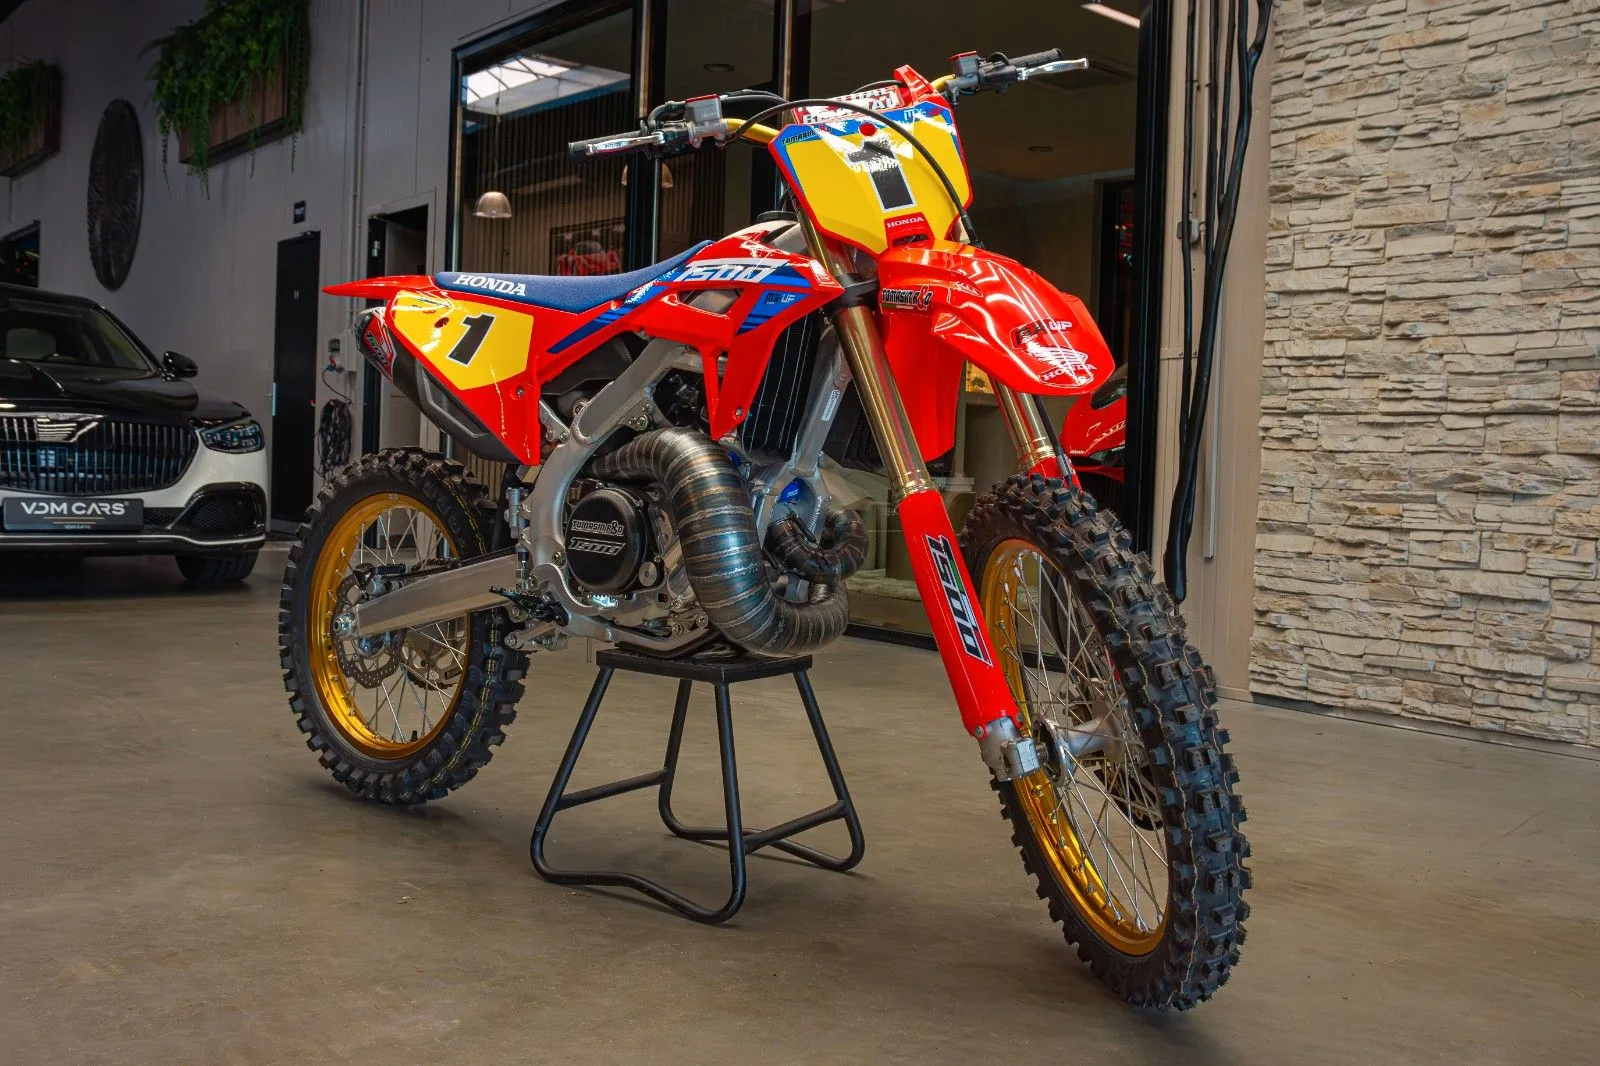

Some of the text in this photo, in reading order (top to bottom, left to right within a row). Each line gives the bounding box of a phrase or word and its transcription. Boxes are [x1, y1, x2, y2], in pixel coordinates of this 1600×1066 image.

[845, 139, 916, 212] 1
[886, 216, 925, 229] HONDA
[453, 274, 527, 297] HONDA
[446, 312, 496, 367] 1
[20, 501, 127, 516] VDM CARS
[571, 519, 606, 534] TOMASIN
